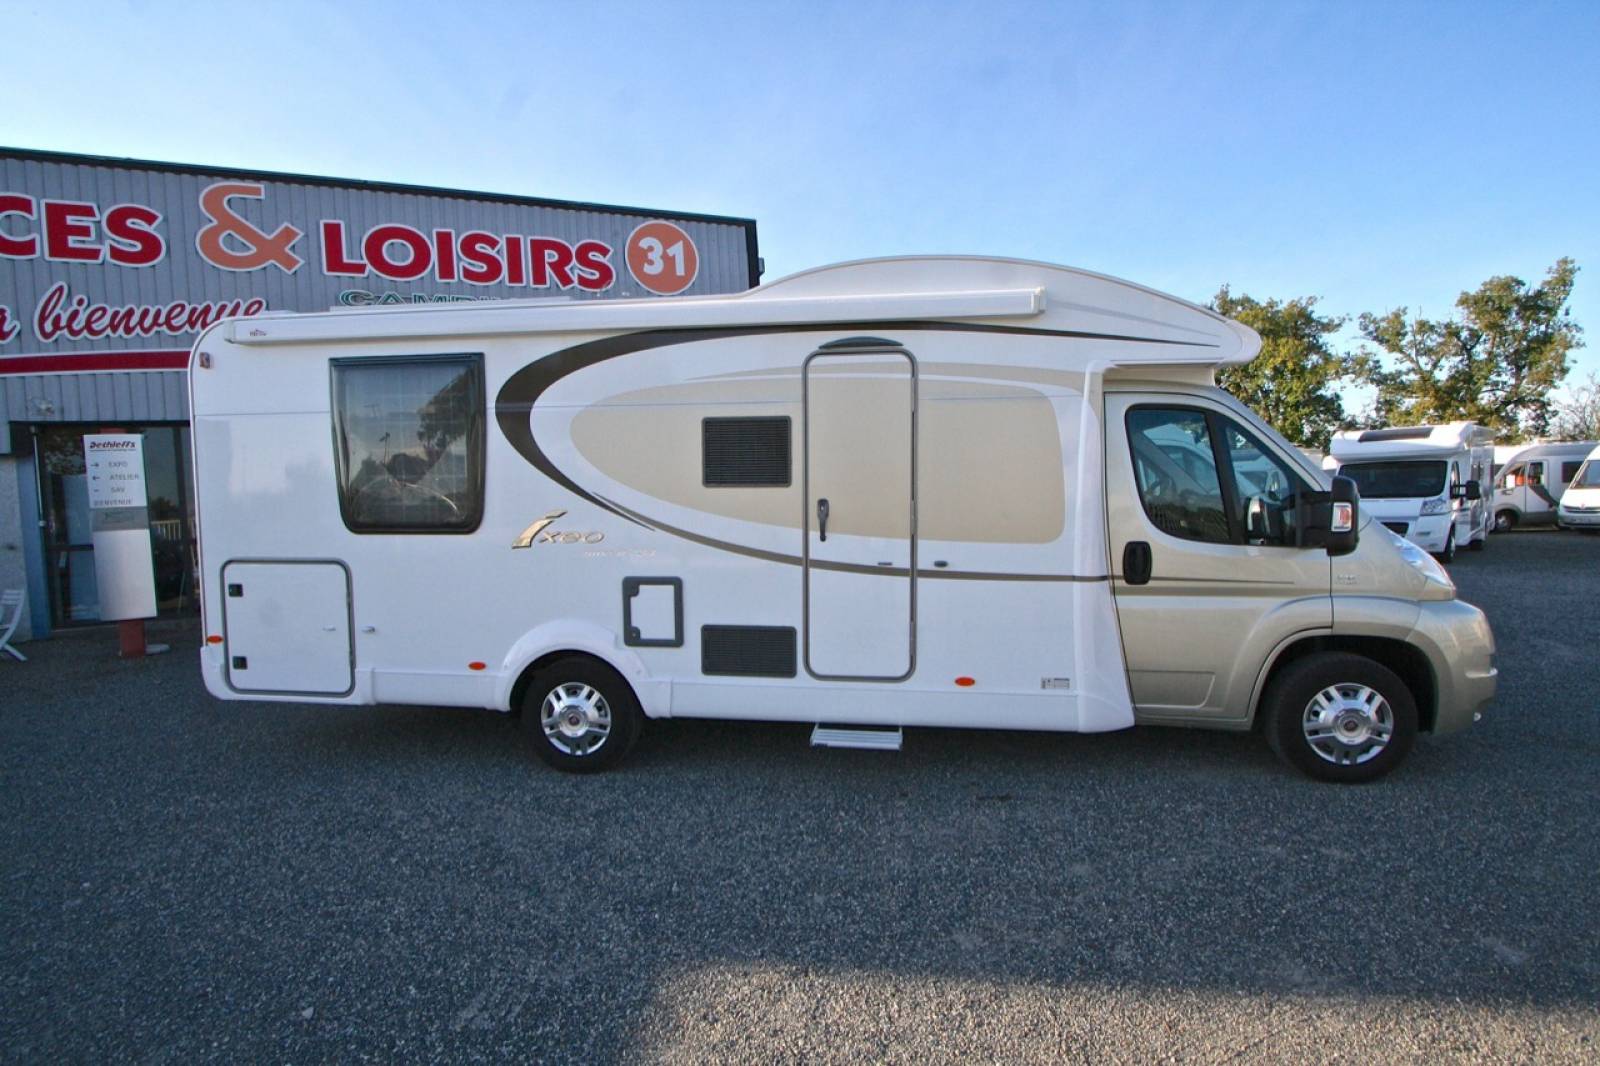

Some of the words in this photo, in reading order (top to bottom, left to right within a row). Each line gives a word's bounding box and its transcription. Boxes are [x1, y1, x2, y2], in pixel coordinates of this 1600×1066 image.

[195, 182, 305, 274] &
[320, 220, 616, 291] LOISIRS
[639, 236, 686, 277] 31
[109, 473, 140, 481] ATELIER
